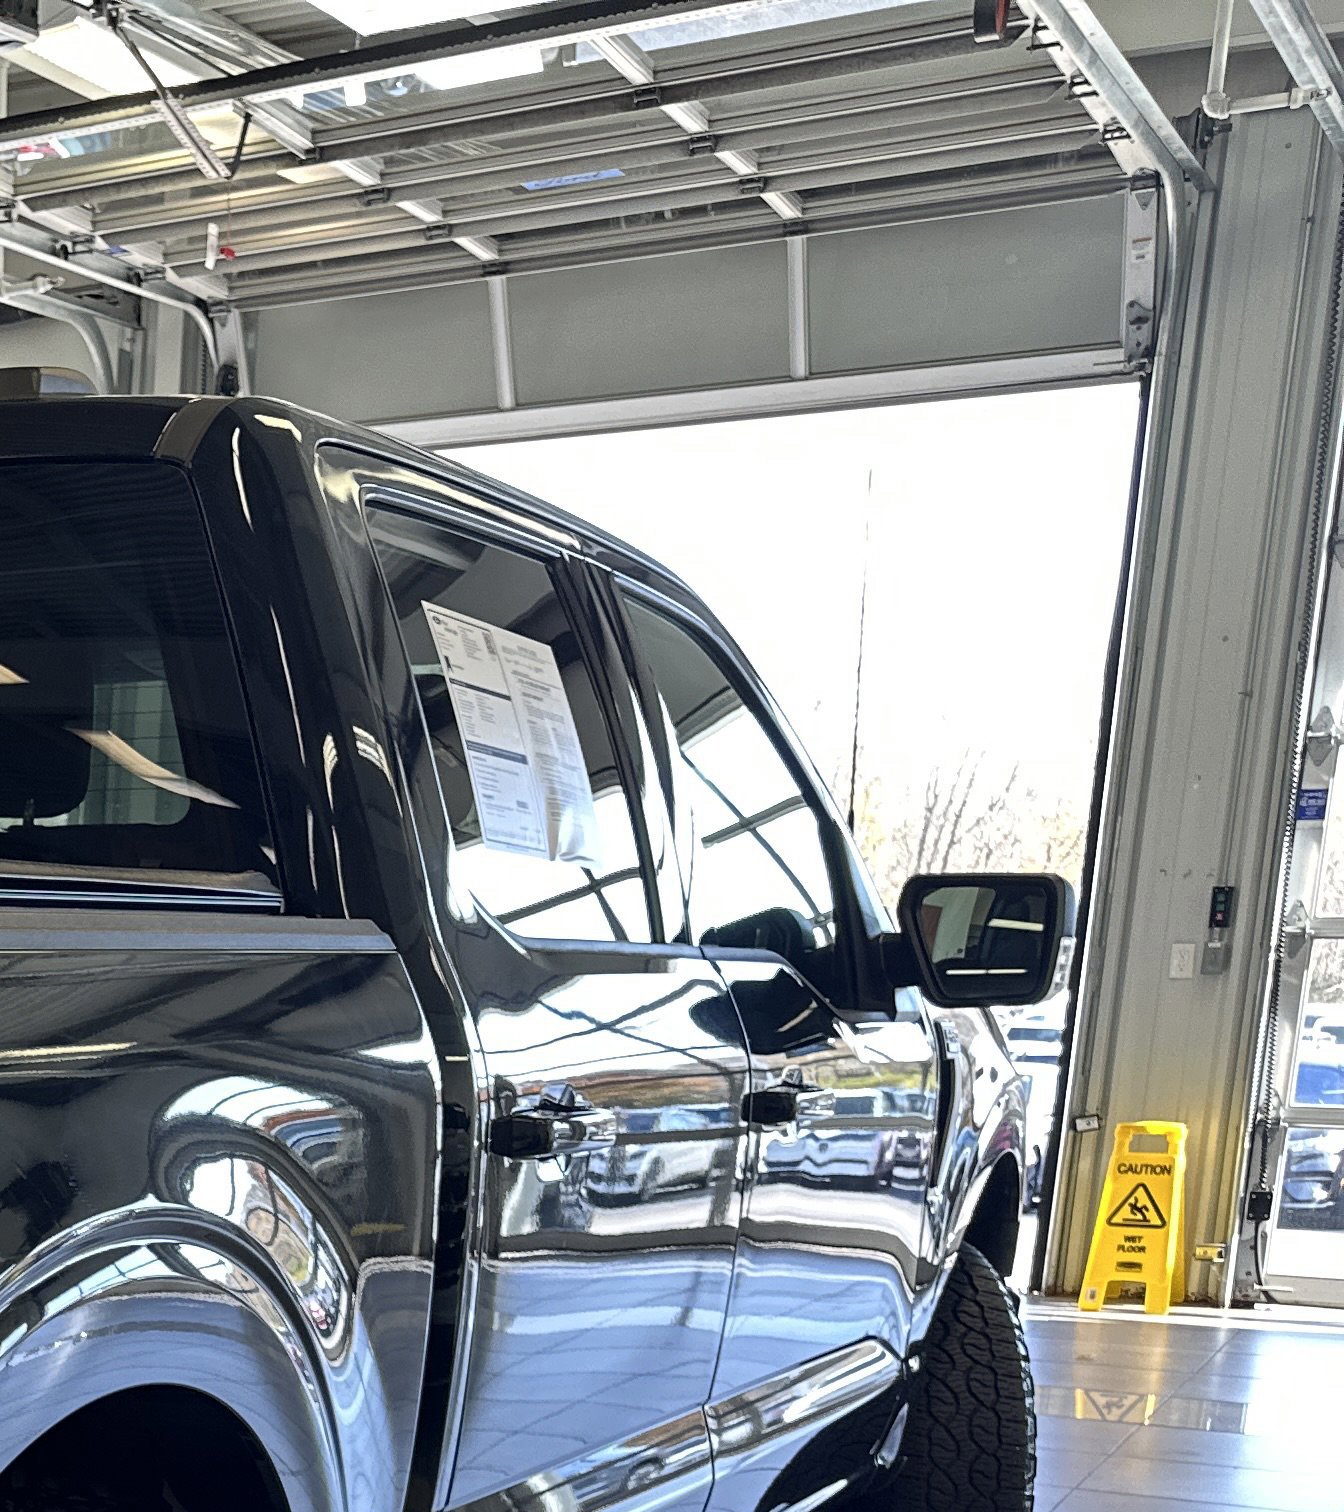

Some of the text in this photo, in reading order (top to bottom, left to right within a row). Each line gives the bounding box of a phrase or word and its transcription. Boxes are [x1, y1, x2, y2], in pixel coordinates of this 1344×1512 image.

[1117, 1162, 1172, 1176] CAUTION
[1123, 1235, 1144, 1244] WET
[1116, 1244, 1147, 1254] FLOOR
